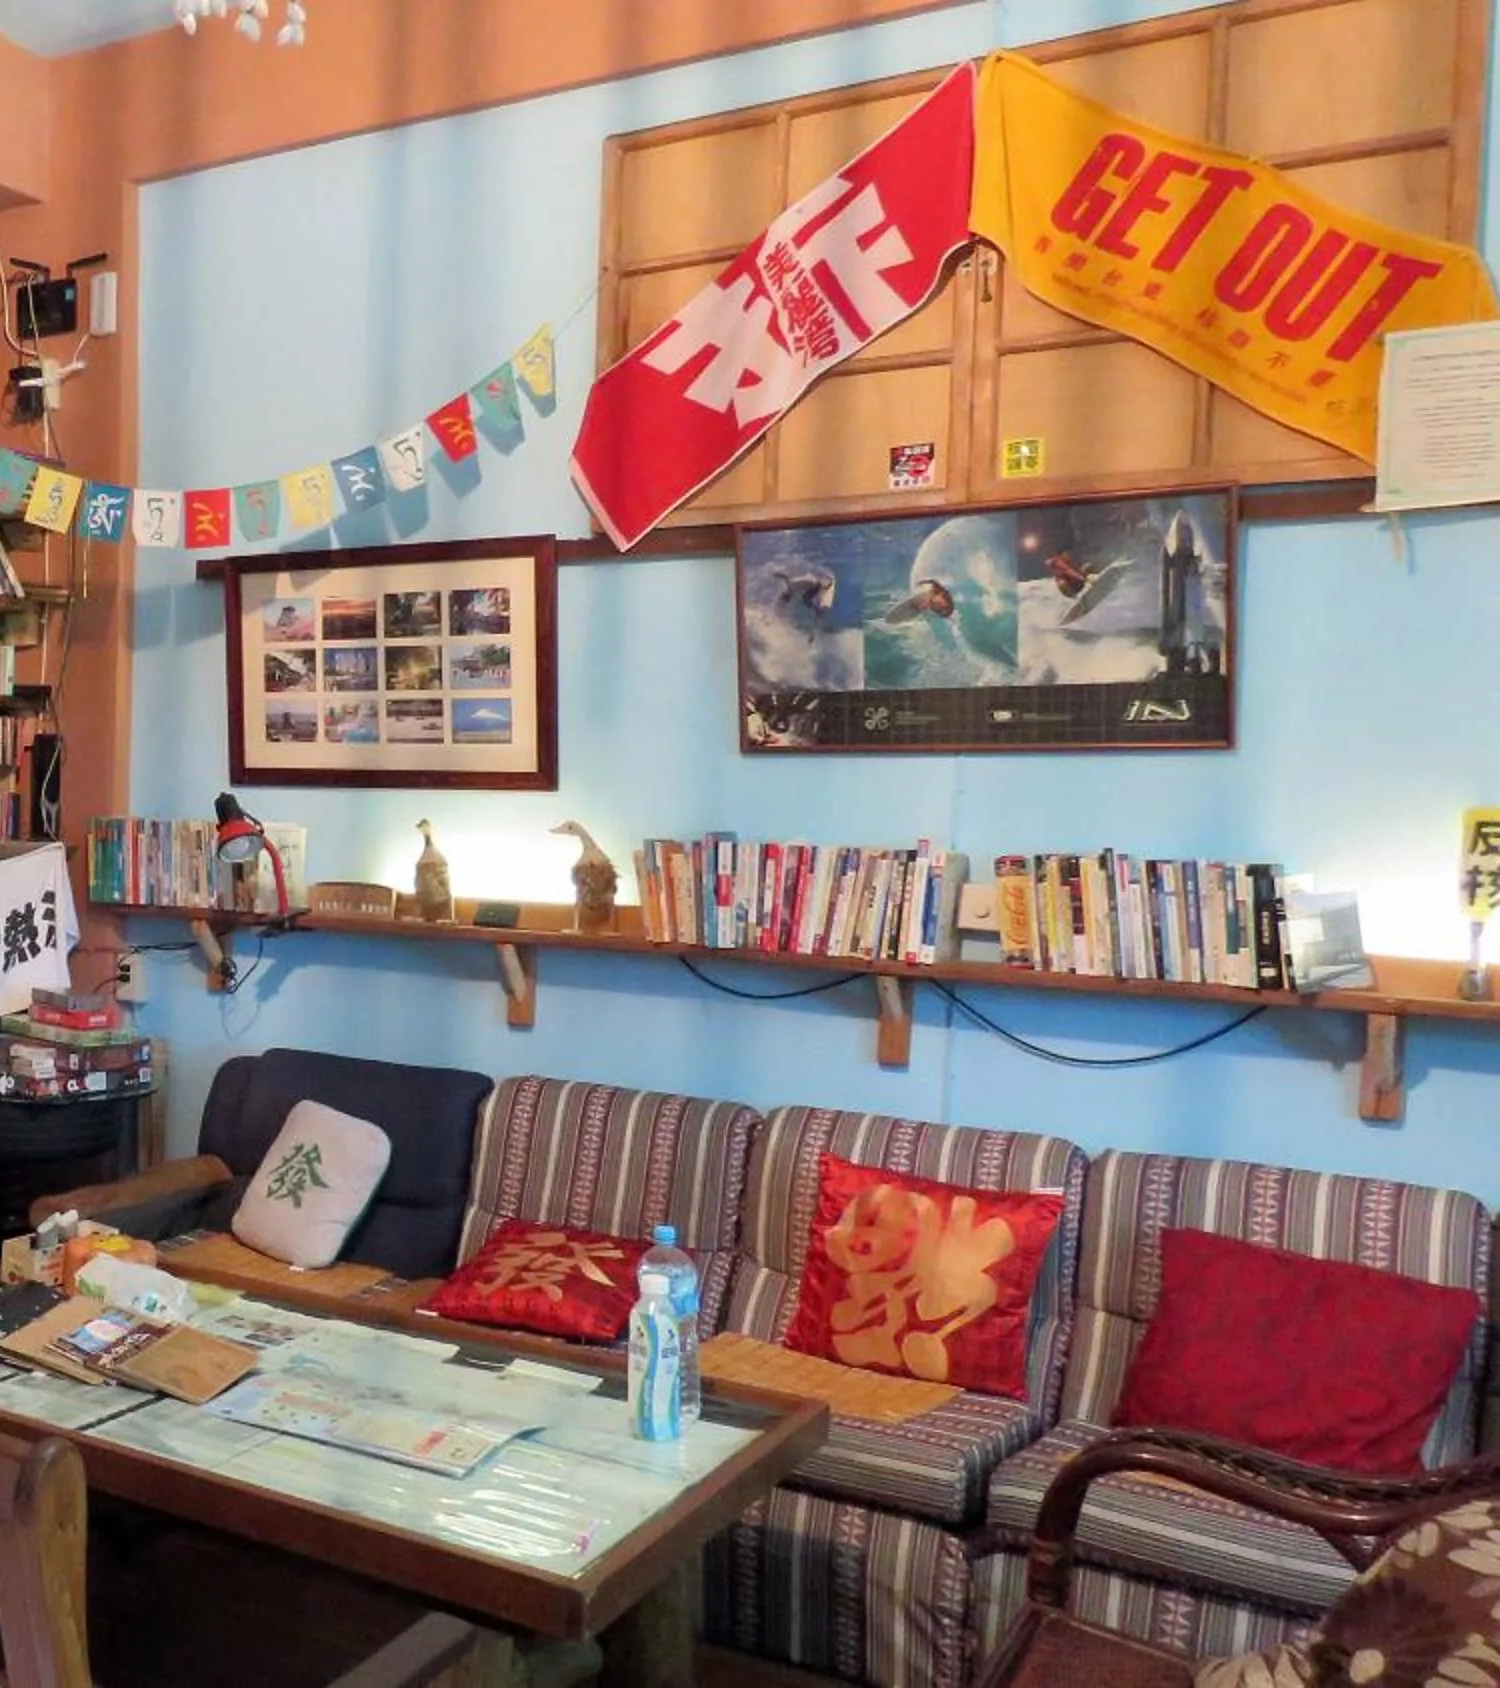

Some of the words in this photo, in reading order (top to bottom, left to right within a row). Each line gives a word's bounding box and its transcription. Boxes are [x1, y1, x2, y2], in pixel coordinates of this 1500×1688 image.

[1049, 133, 1253, 273] GET
[1212, 203, 1443, 362] OUT
[266, 1142, 330, 1209] 發
